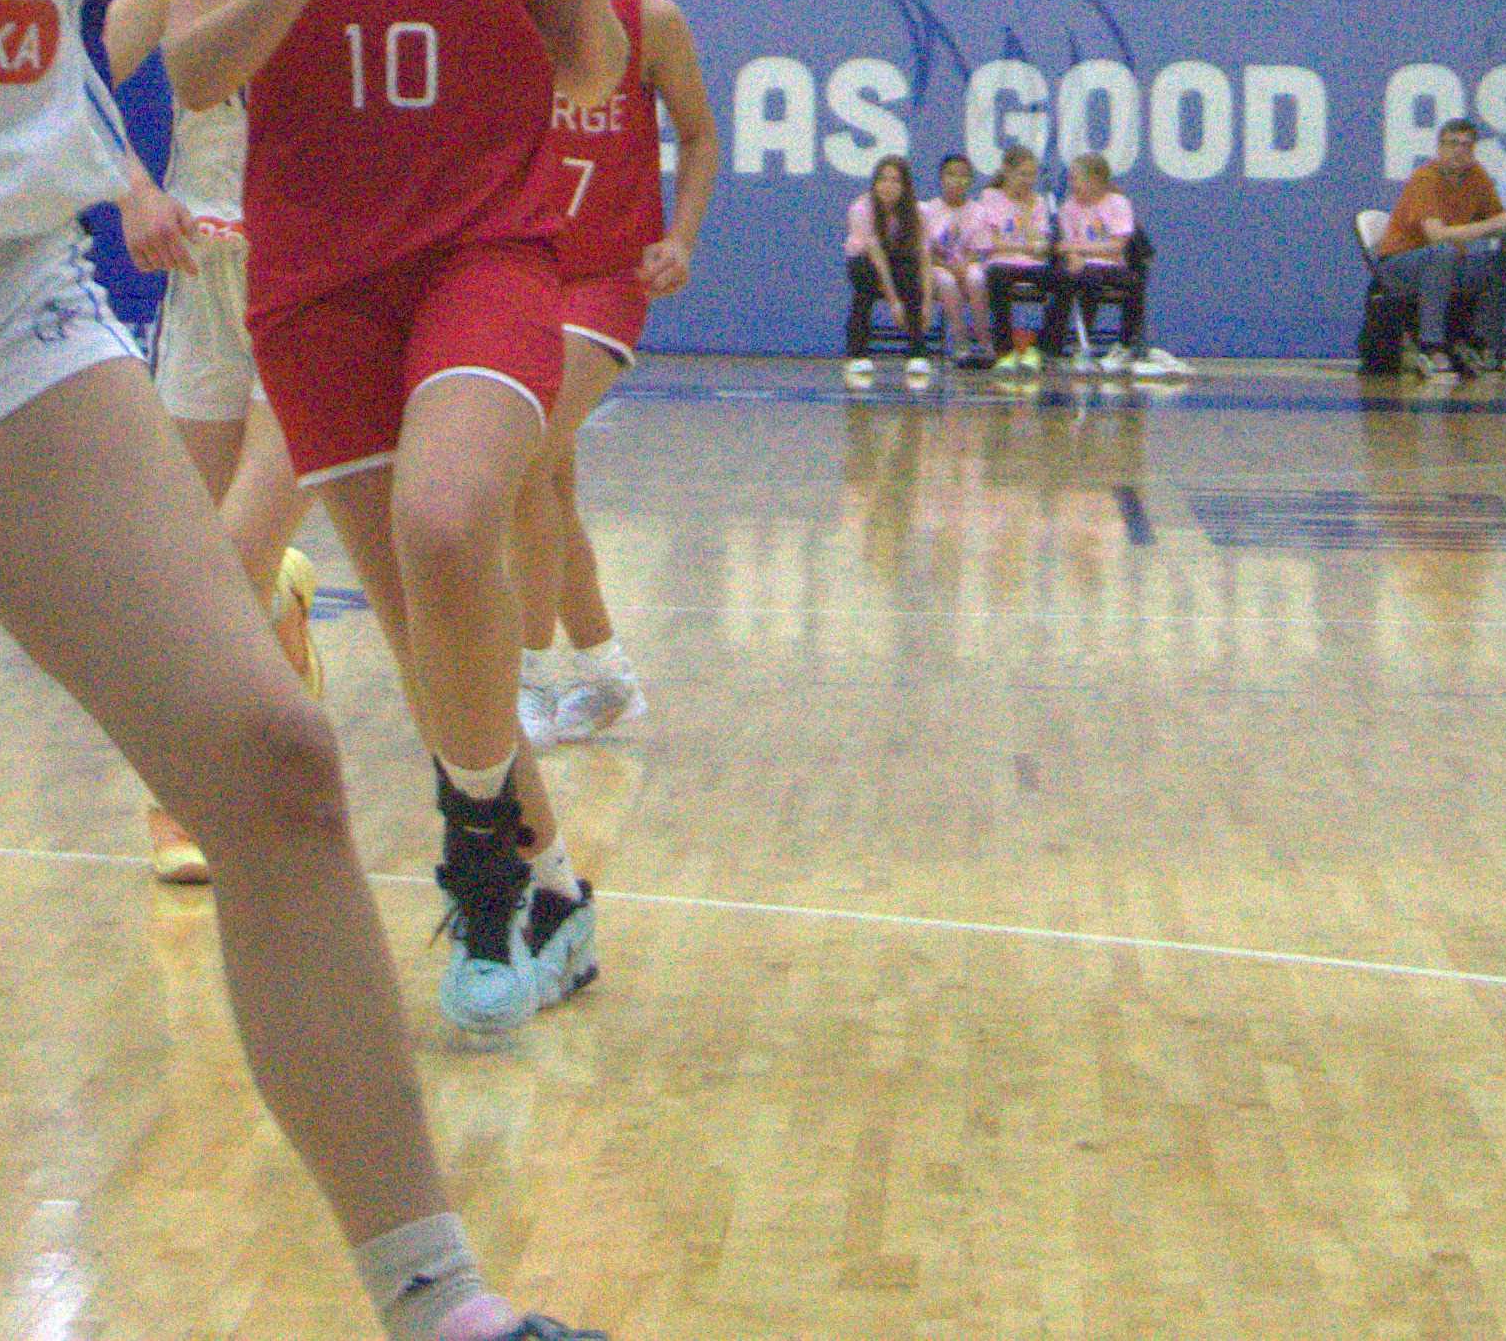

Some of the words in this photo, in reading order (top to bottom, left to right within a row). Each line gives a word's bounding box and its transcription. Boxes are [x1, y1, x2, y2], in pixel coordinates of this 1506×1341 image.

[343, 21, 440, 109] 10
[733, 56, 910, 175] AS
[964, 58, 1327, 181] GOOD
[561, 155, 596, 218] 7
